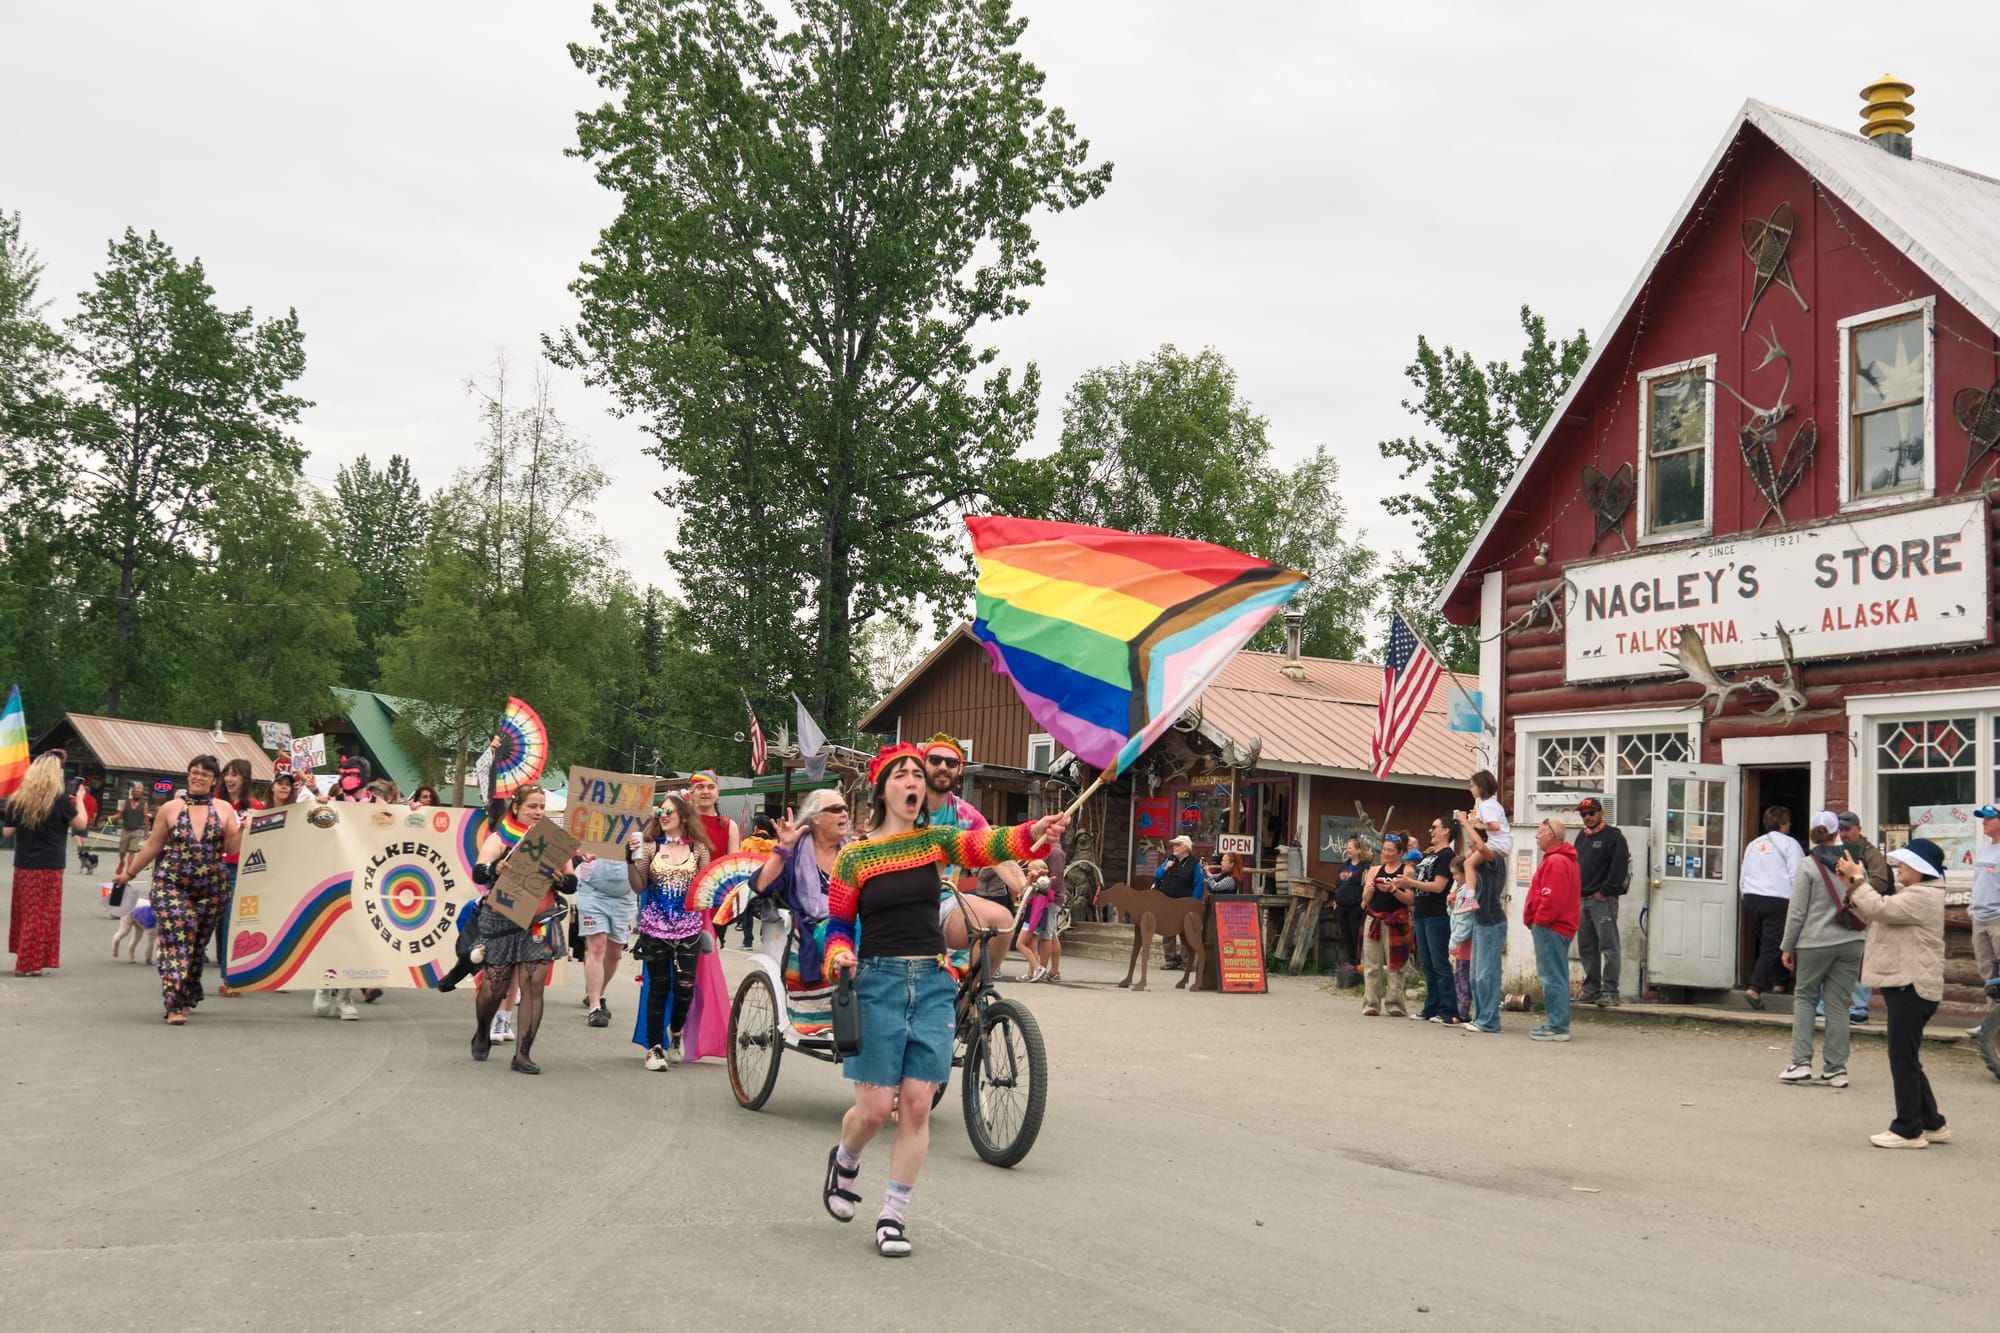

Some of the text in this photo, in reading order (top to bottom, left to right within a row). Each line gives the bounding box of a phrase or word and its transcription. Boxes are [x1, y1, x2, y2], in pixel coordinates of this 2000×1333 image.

[1708, 534, 1800, 558] SINCE 1921
[1585, 531, 1963, 622] NAGLEY'S STORE
[1615, 596, 1920, 655] TALKETNA, ALASKA
[154, 782, 172, 791] OPEN
[578, 776, 654, 813] YAYYY
[570, 805, 652, 845] GAYYY
[1222, 838, 1251, 852] OPEN
[364, 842, 455, 892] TALKEETNA
[365, 900, 402, 952] FEST
[408, 902, 456, 954] PRIDE
